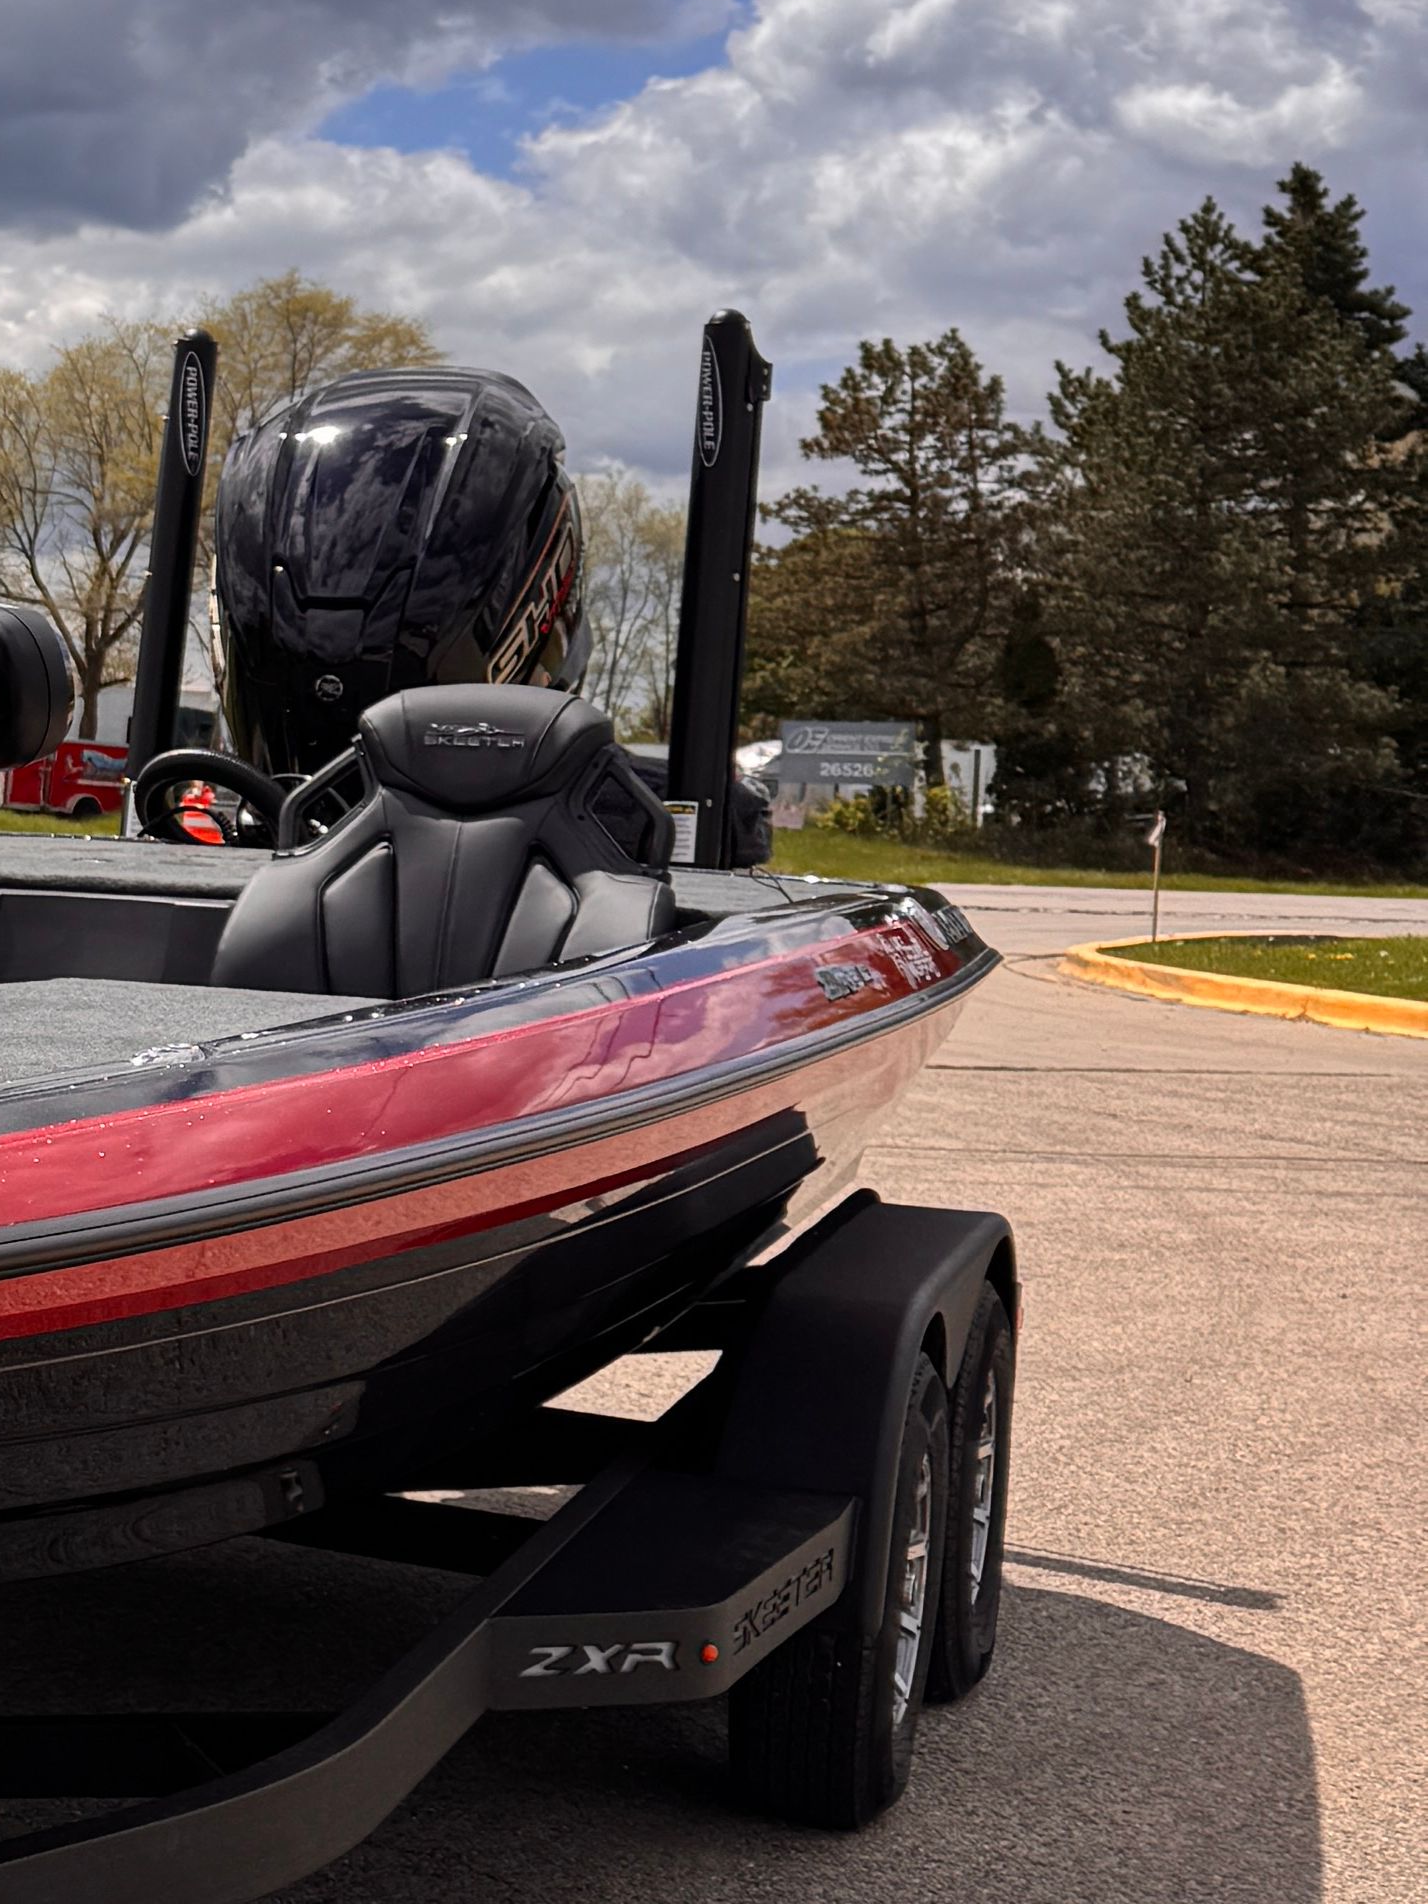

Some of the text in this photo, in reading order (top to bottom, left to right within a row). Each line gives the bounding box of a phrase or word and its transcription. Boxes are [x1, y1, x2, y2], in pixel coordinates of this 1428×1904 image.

[185, 365, 199, 460] POWER-POLE
[701, 350, 716, 450] POWER-POLE
[733, 1547, 835, 1656] SKEETER
[519, 1641, 679, 1678] ZXR
